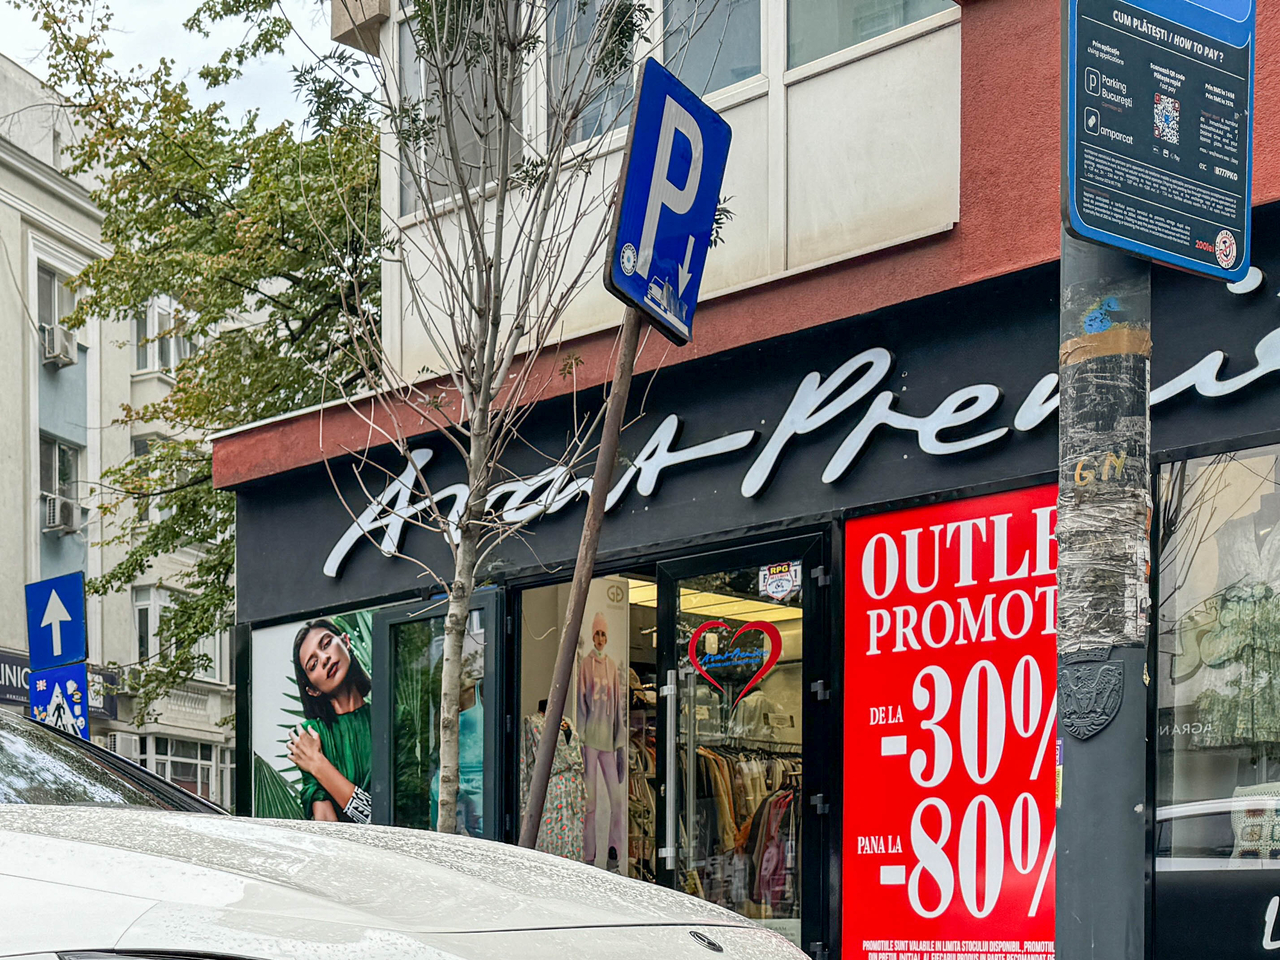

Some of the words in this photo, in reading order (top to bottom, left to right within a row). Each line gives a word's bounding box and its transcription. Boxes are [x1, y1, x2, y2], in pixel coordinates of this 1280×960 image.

[1113, 10, 1131, 27] CUM
[1174, 34, 1192, 51] HOW
[1194, 41, 1203, 54] TO
[1204, 46, 1218, 60] PAY
[1102, 74, 1126, 94] Parking
[1101, 126, 1133, 144] amparcat
[636, 94, 704, 280] P
[770, 565, 788, 574] RPG
[870, 706, 886, 725] DE
[887, 705, 903, 724] LA
[858, 836, 886, 854] PANA
[888, 835, 902, 853] LA
[894, 940, 908, 951] SUNT
[909, 940, 934, 951] VALABILE
[935, 940, 941, 951] IN
[943, 941, 960, 952] LIMITA
[962, 941, 988, 952] STOCULUI
